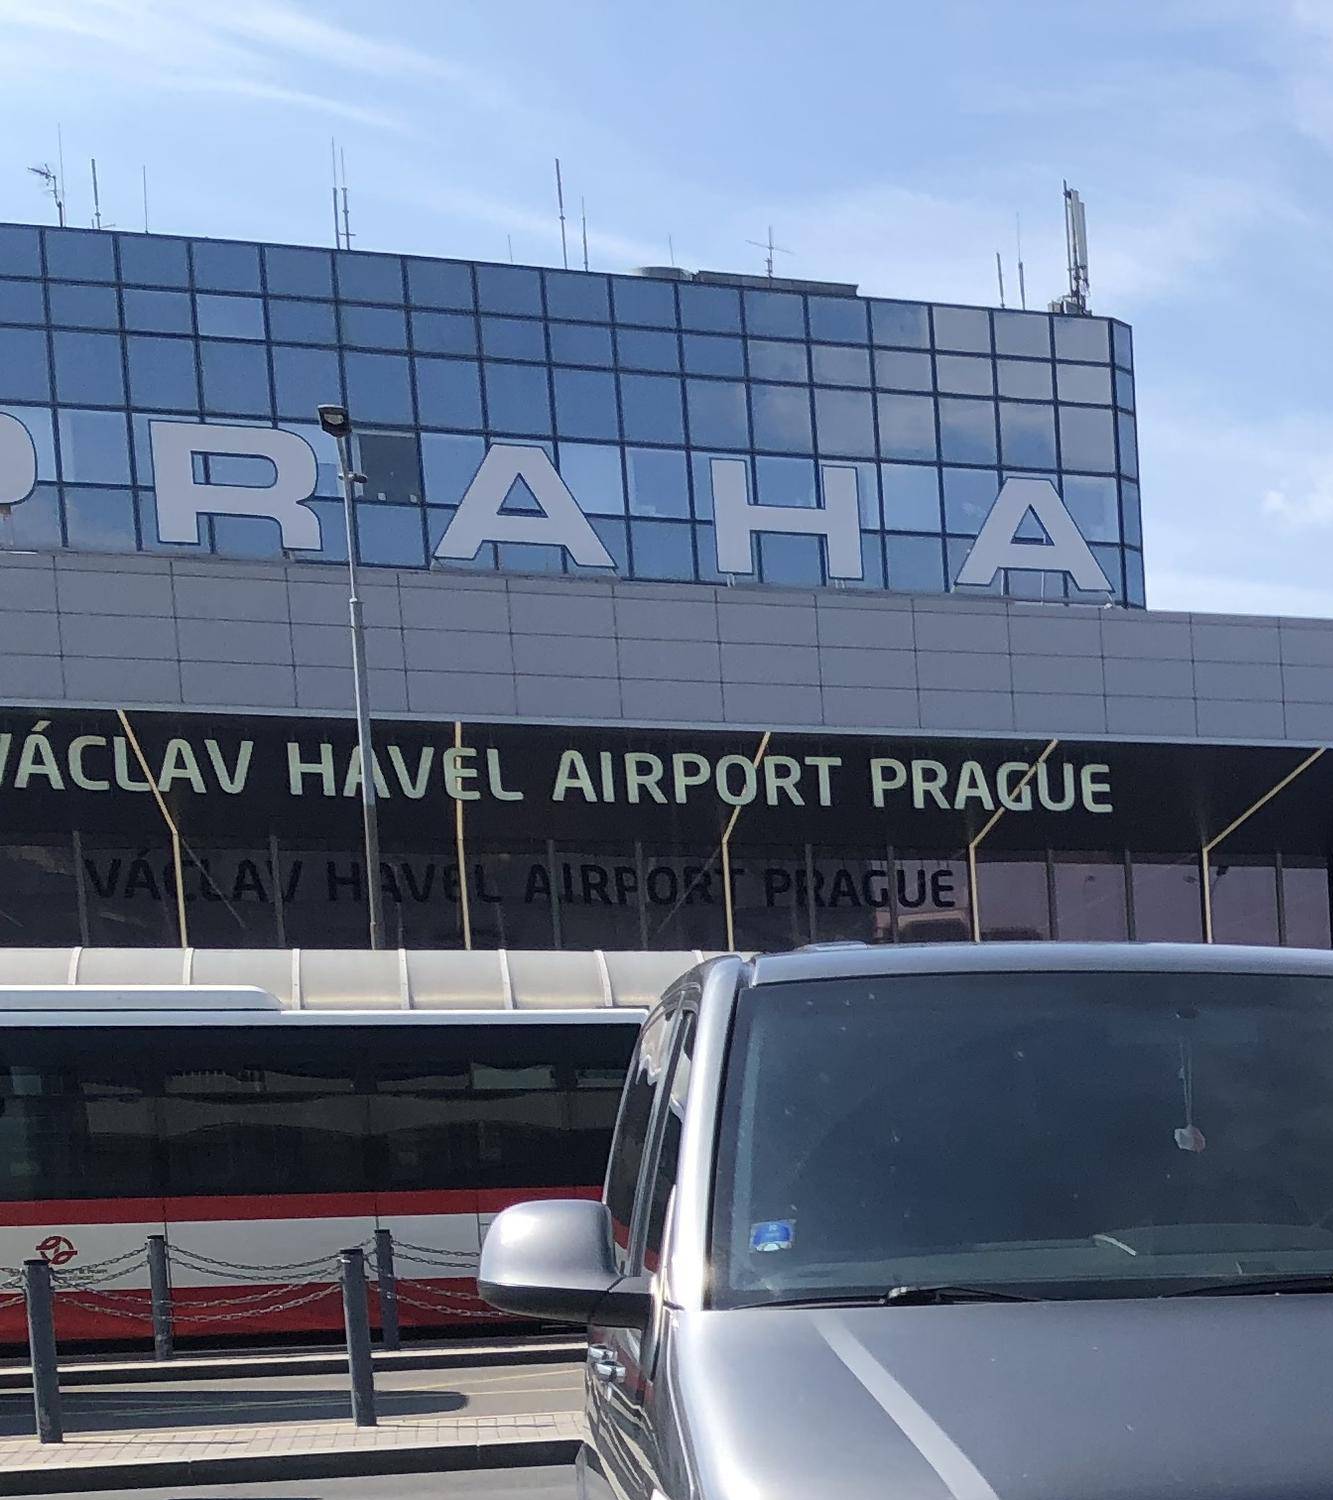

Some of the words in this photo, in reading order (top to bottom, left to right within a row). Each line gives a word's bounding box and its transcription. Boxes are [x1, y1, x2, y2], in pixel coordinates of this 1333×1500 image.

[0, 411, 1115, 592] RAHA
[0, 720, 254, 794] ÁCLAV
[287, 742, 524, 801] HAVEL
[552, 749, 842, 807] AIRPORT
[870, 757, 1113, 815] PRAGUE
